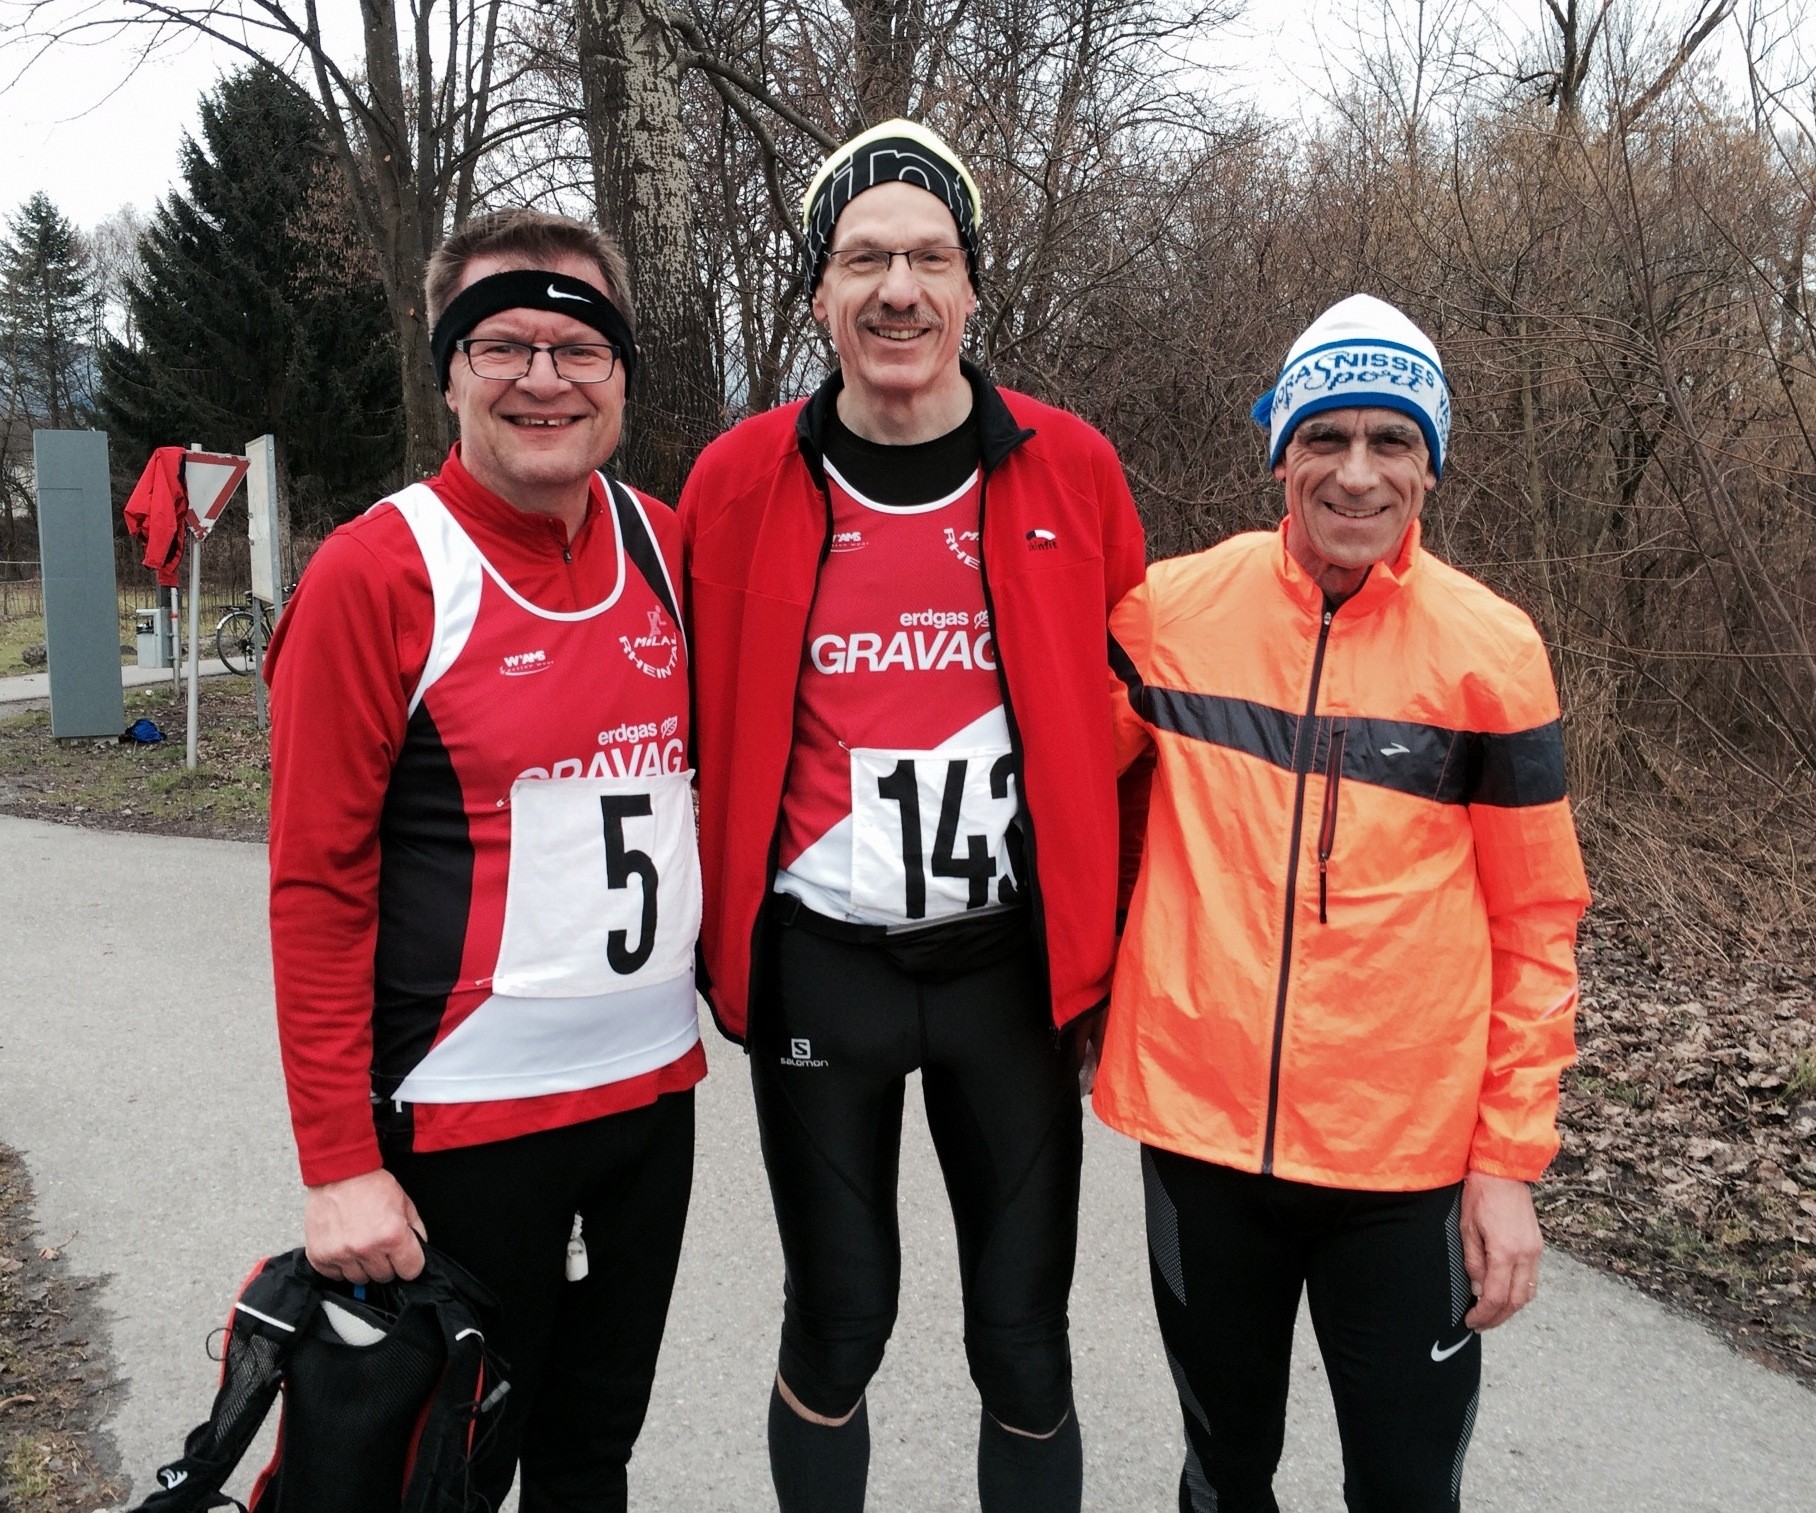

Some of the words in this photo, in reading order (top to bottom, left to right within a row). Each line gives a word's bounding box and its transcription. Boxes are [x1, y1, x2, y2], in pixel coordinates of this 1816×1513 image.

[1334, 353, 1434, 388] NISSES
[899, 608, 969, 629] erdgas
[597, 721, 658, 746] erdgas
[599, 793, 659, 975] 5
